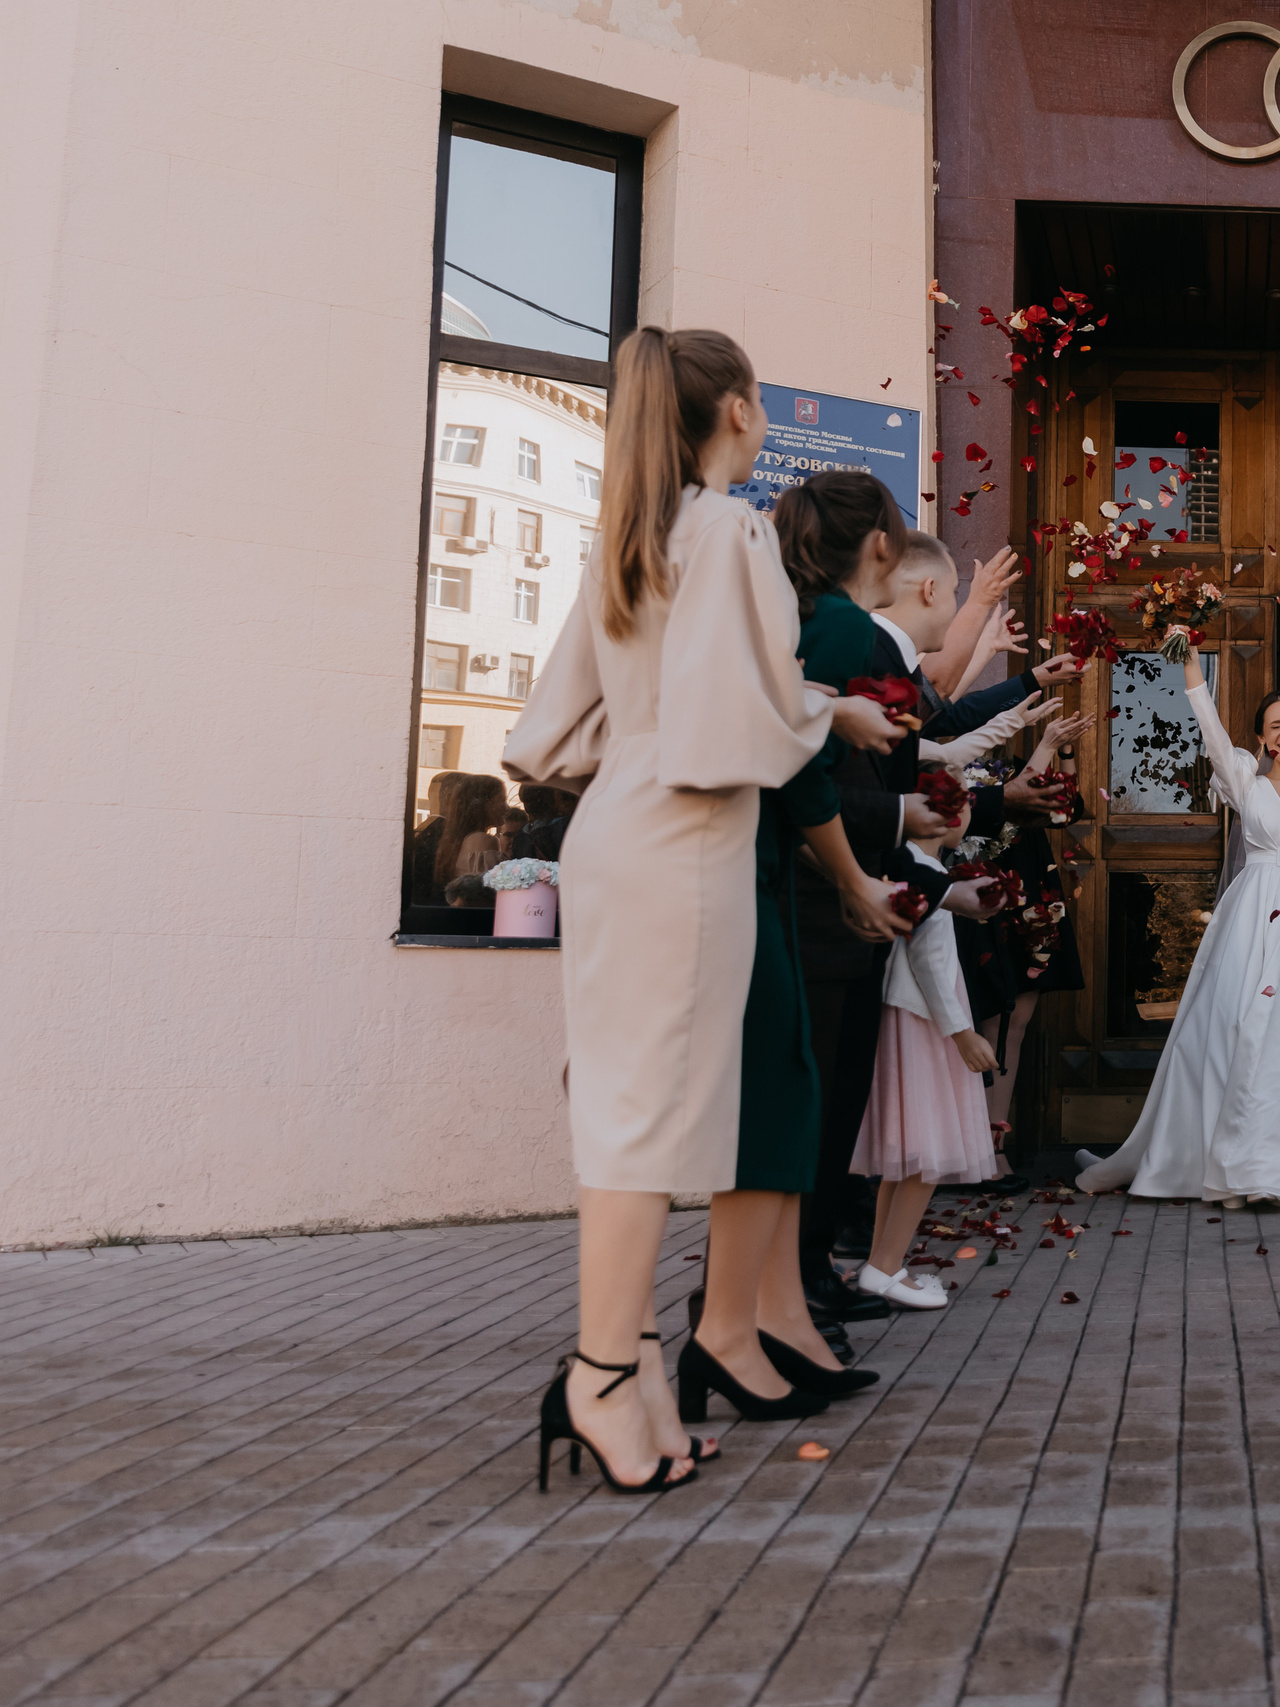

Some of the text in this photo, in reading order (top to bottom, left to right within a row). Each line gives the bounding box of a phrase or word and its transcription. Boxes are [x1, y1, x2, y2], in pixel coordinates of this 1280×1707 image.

[821, 431, 853, 442] Москвы
[775, 438, 837, 453] города Москвы
[783, 432, 807, 441] актов
[808, 436, 865, 451] гражданского
[865, 446, 906, 459] состояния
[752, 469, 805, 486] отдел
